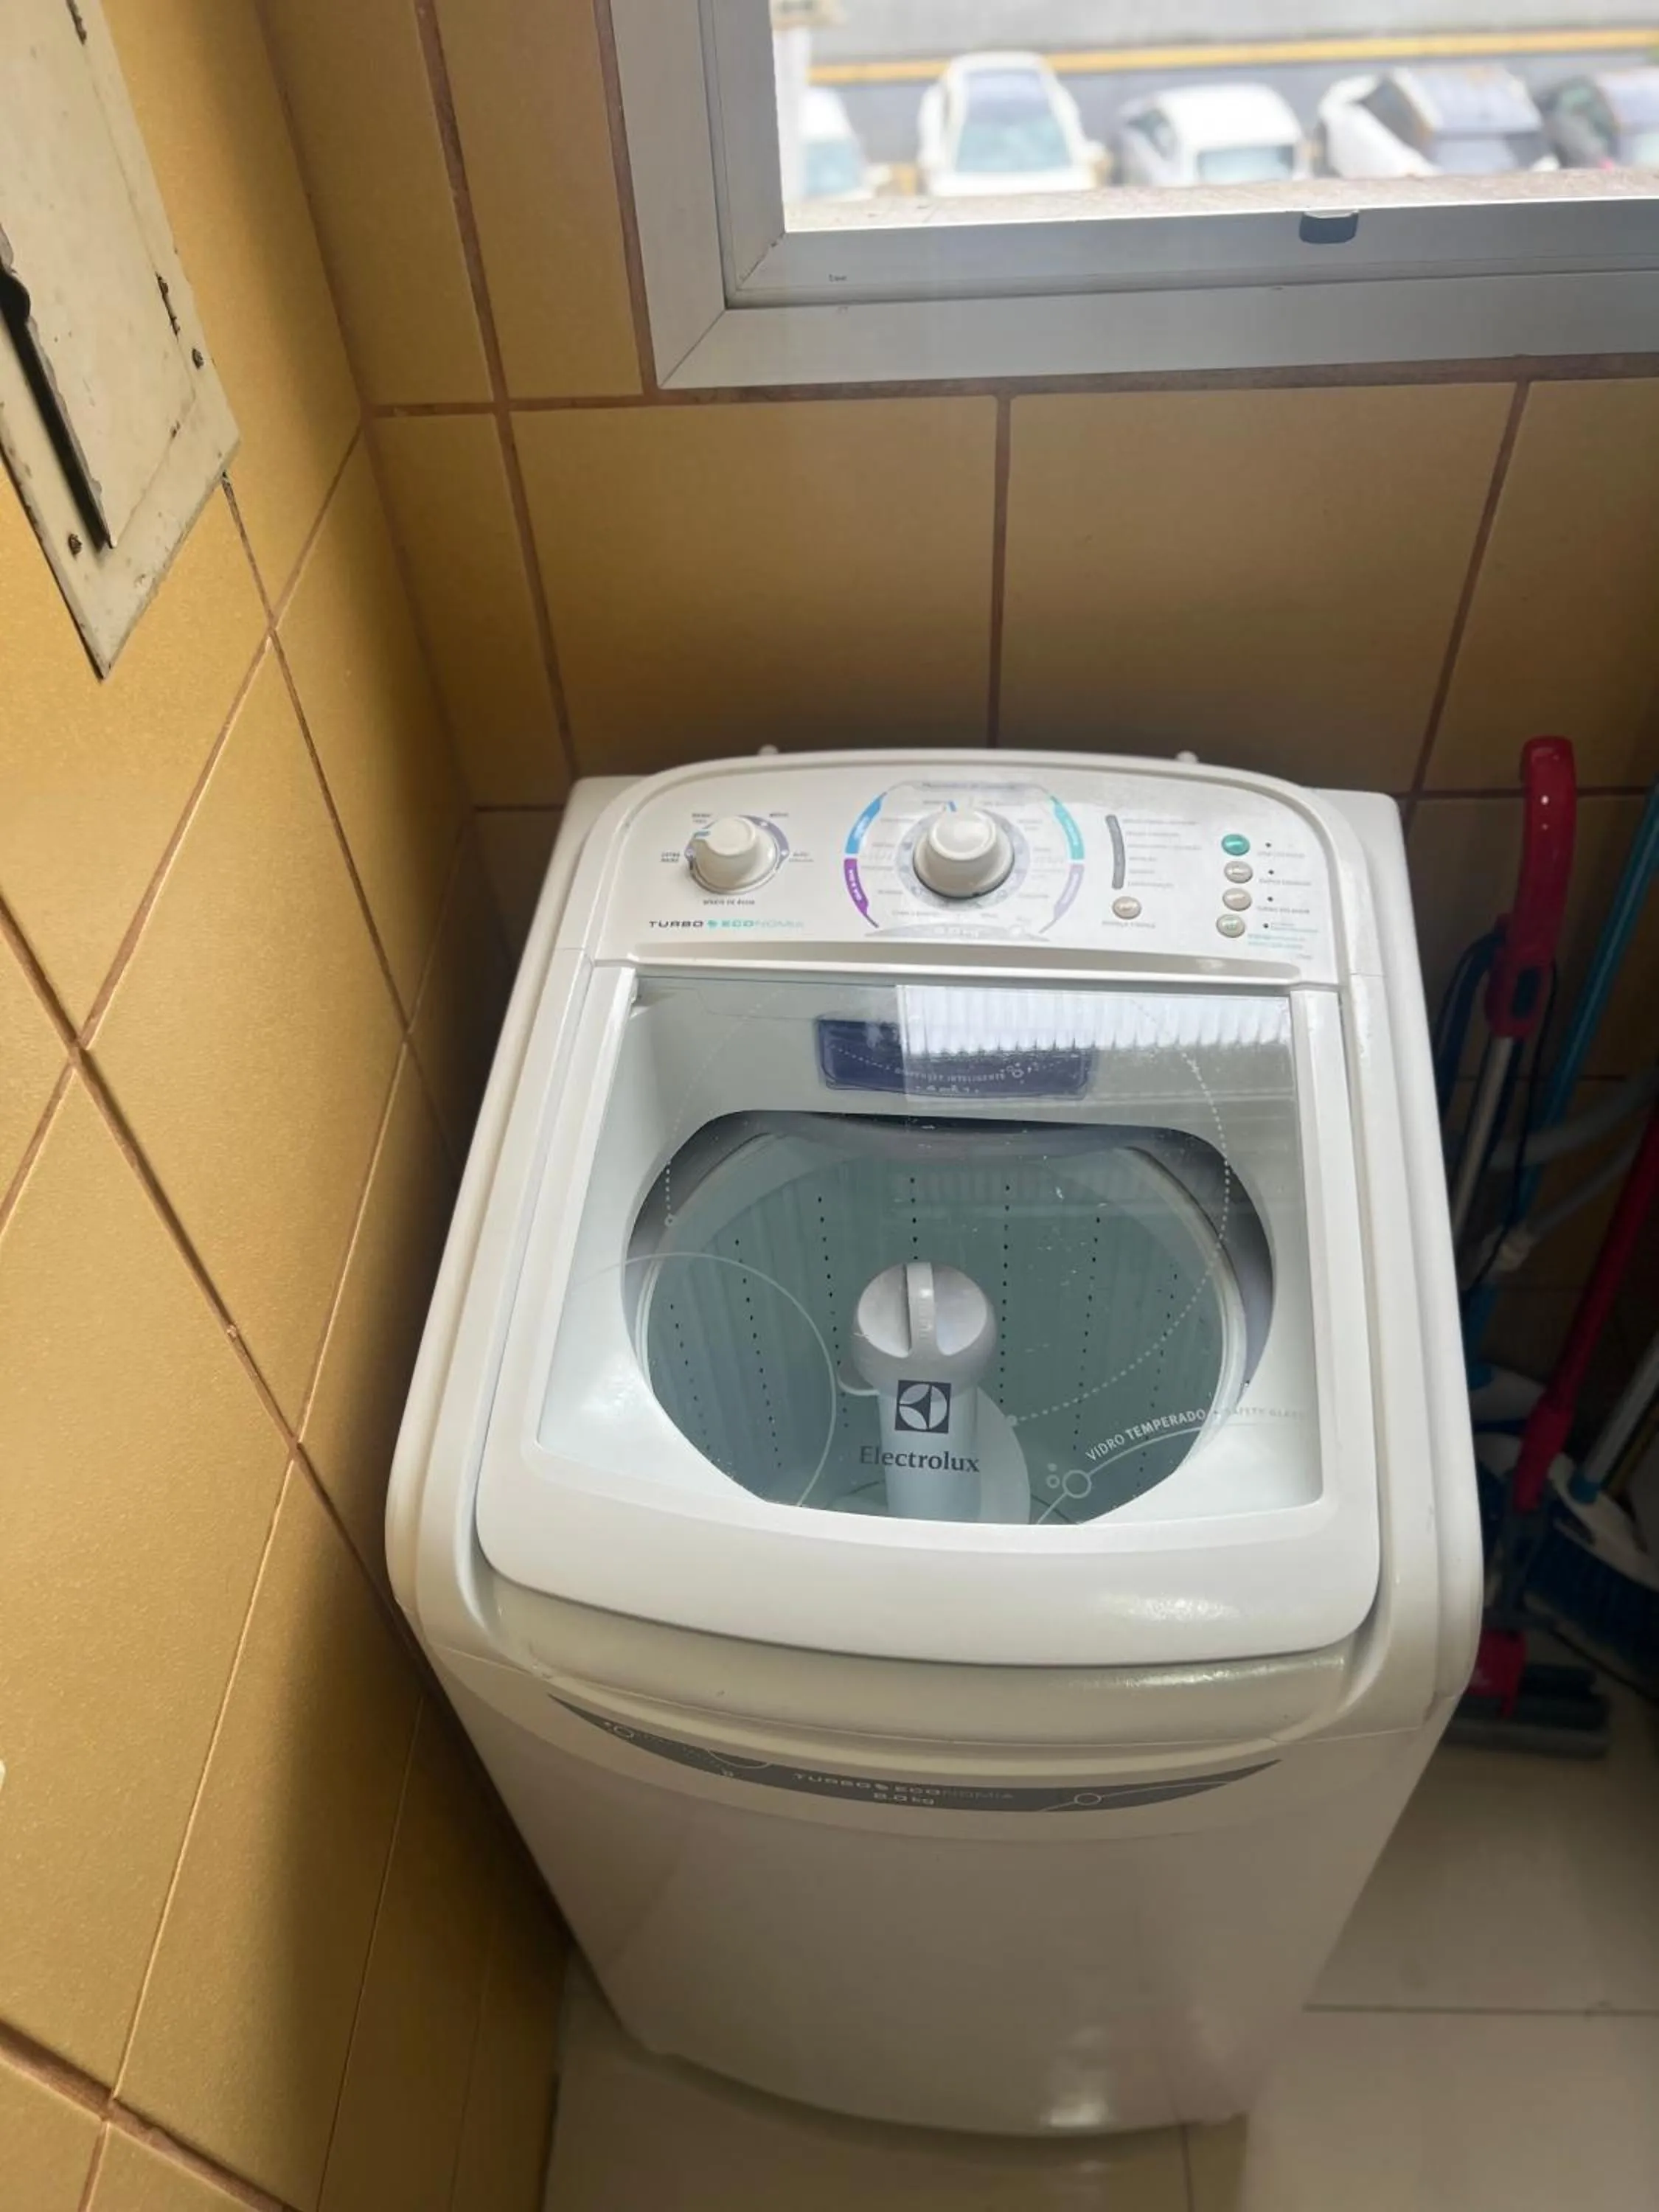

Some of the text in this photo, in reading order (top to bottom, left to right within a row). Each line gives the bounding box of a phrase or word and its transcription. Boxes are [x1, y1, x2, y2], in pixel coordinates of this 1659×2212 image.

[1085, 1433, 1124, 1461] VIDRO
[1124, 1408, 1206, 1440] TEMPERADO
[860, 1445, 980, 1472] Electrolux
